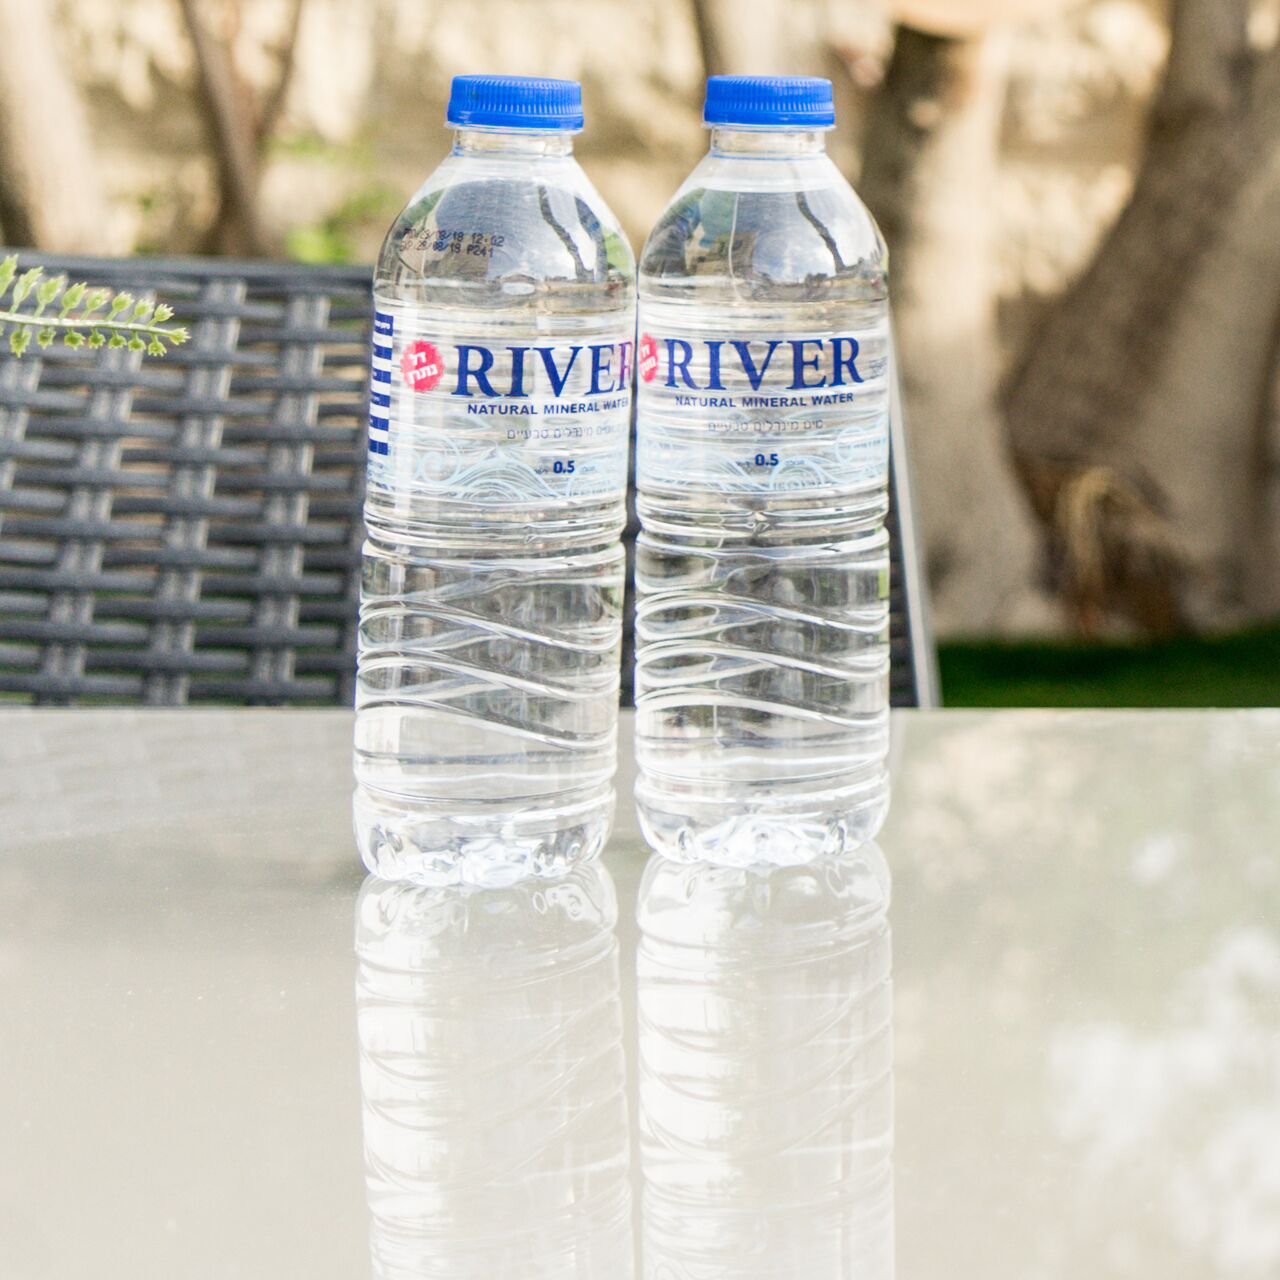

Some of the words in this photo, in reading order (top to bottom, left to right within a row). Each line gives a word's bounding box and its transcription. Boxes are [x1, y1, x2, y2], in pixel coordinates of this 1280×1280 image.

[409, 351, 427, 366] דל
[664, 337, 865, 391] RIVER
[407, 363, 439, 385] נתרן
[450, 341, 633, 398] RIVER
[675, 396, 736, 408] NATURAL
[742, 396, 807, 408] MINERAL
[811, 393, 854, 406] WATER
[467, 404, 538, 415] NATURAL
[543, 403, 600, 414] MINERAL
[553, 460, 575, 473] 0.5
[755, 453, 779, 466] 0.5
